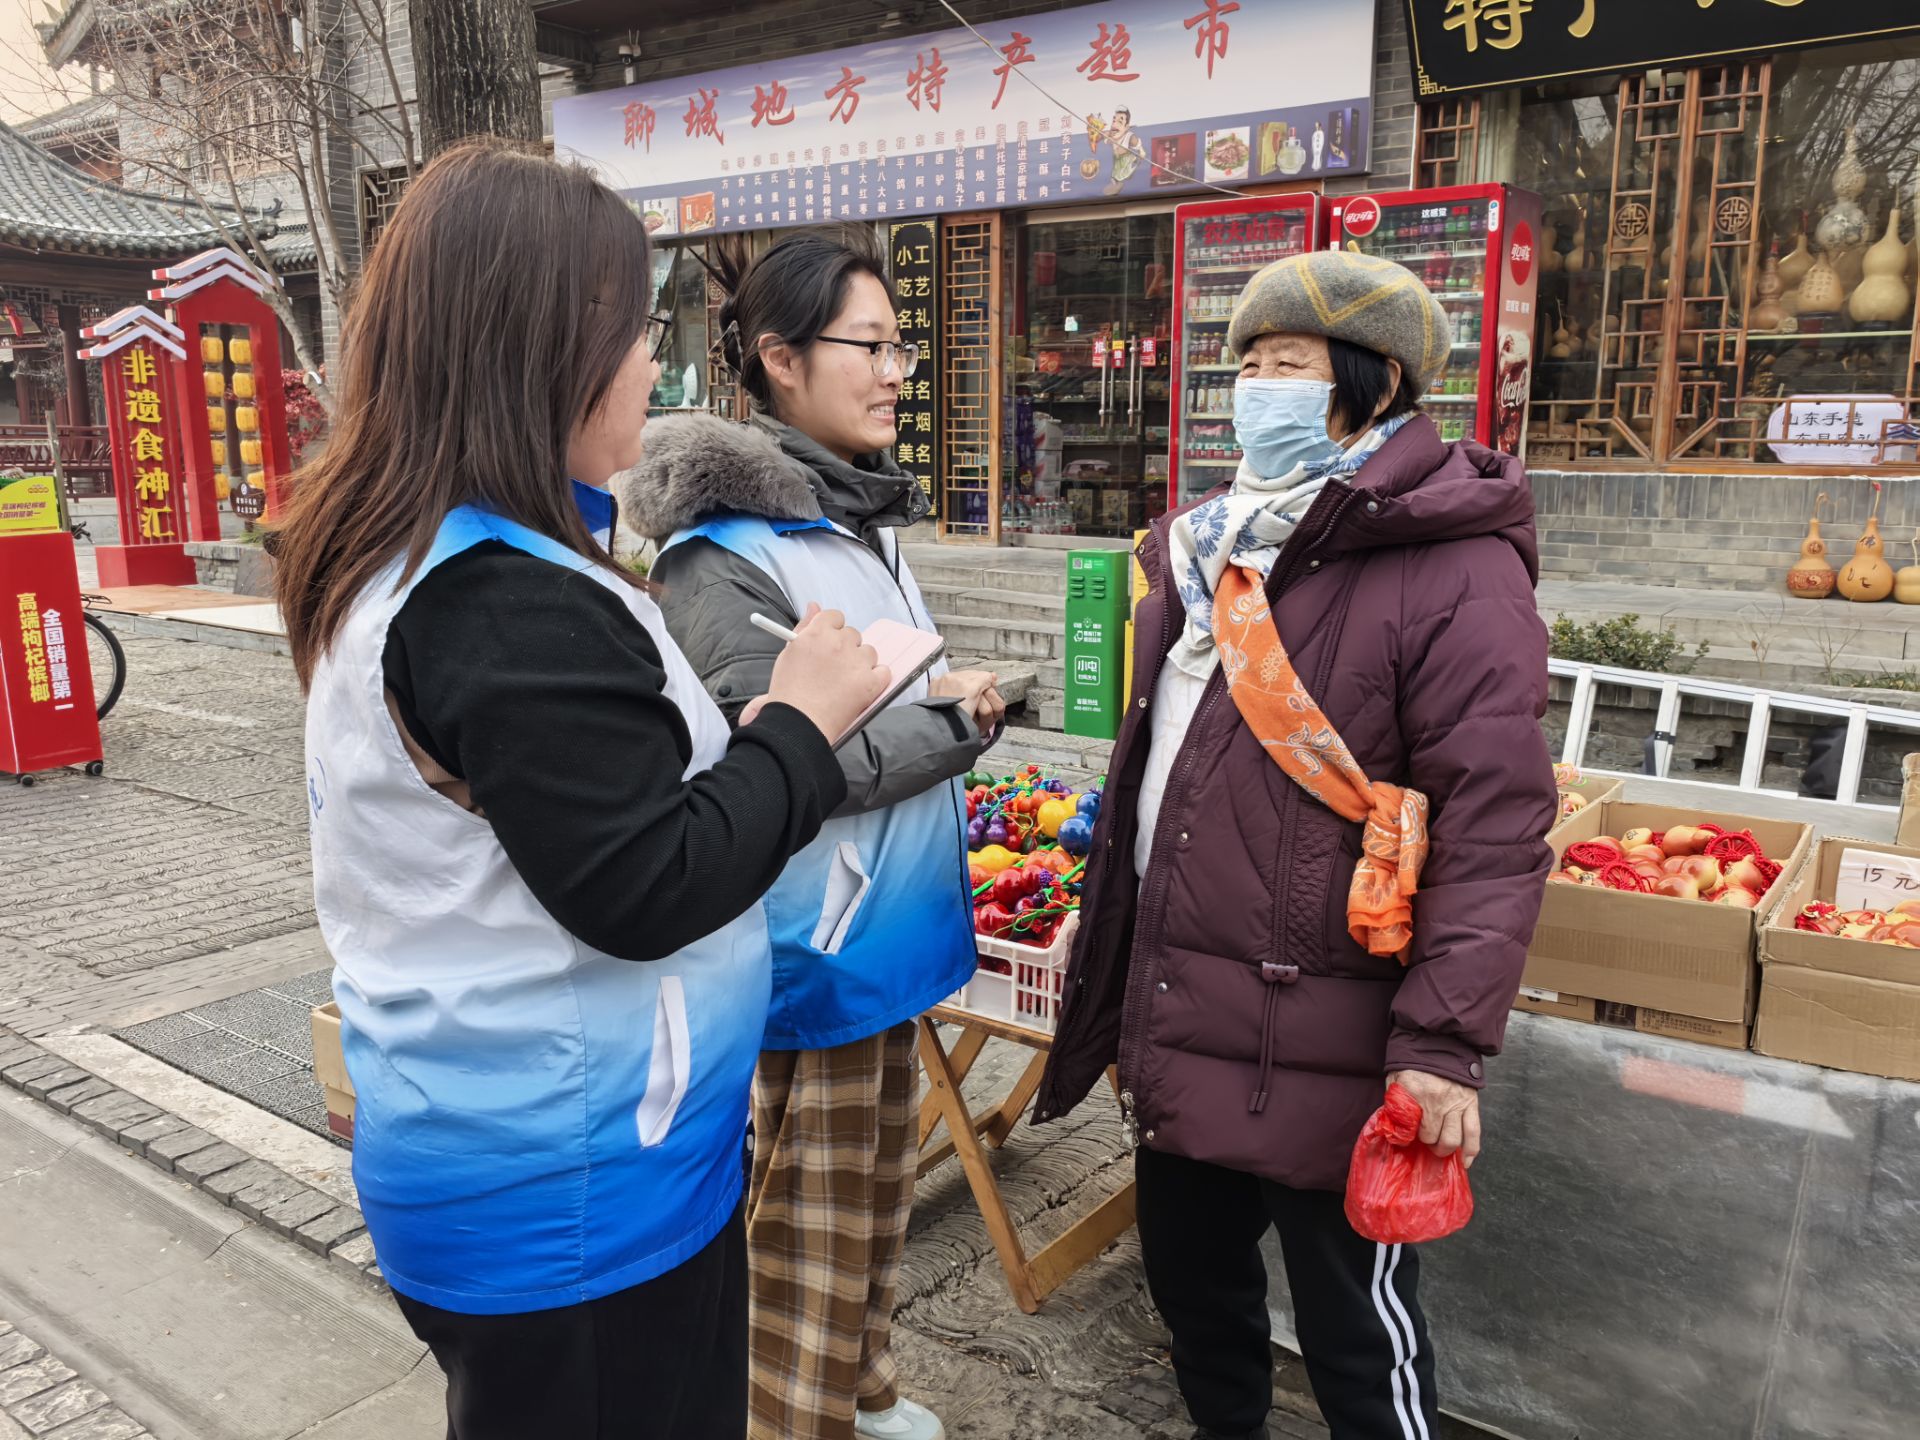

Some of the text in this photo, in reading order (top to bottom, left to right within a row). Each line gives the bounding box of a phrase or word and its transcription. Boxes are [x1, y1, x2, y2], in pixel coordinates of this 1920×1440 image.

[622, 0, 1241, 154] 聊城地方特产超市
[1203, 215, 1286, 246] 农夫山泉
[122, 348, 175, 538] 非遗食神汇
[17, 592, 50, 703] 高端枸杞槟榔
[42, 608, 74, 711] 全国销量第一
[1863, 866, 1920, 890] 15 元
